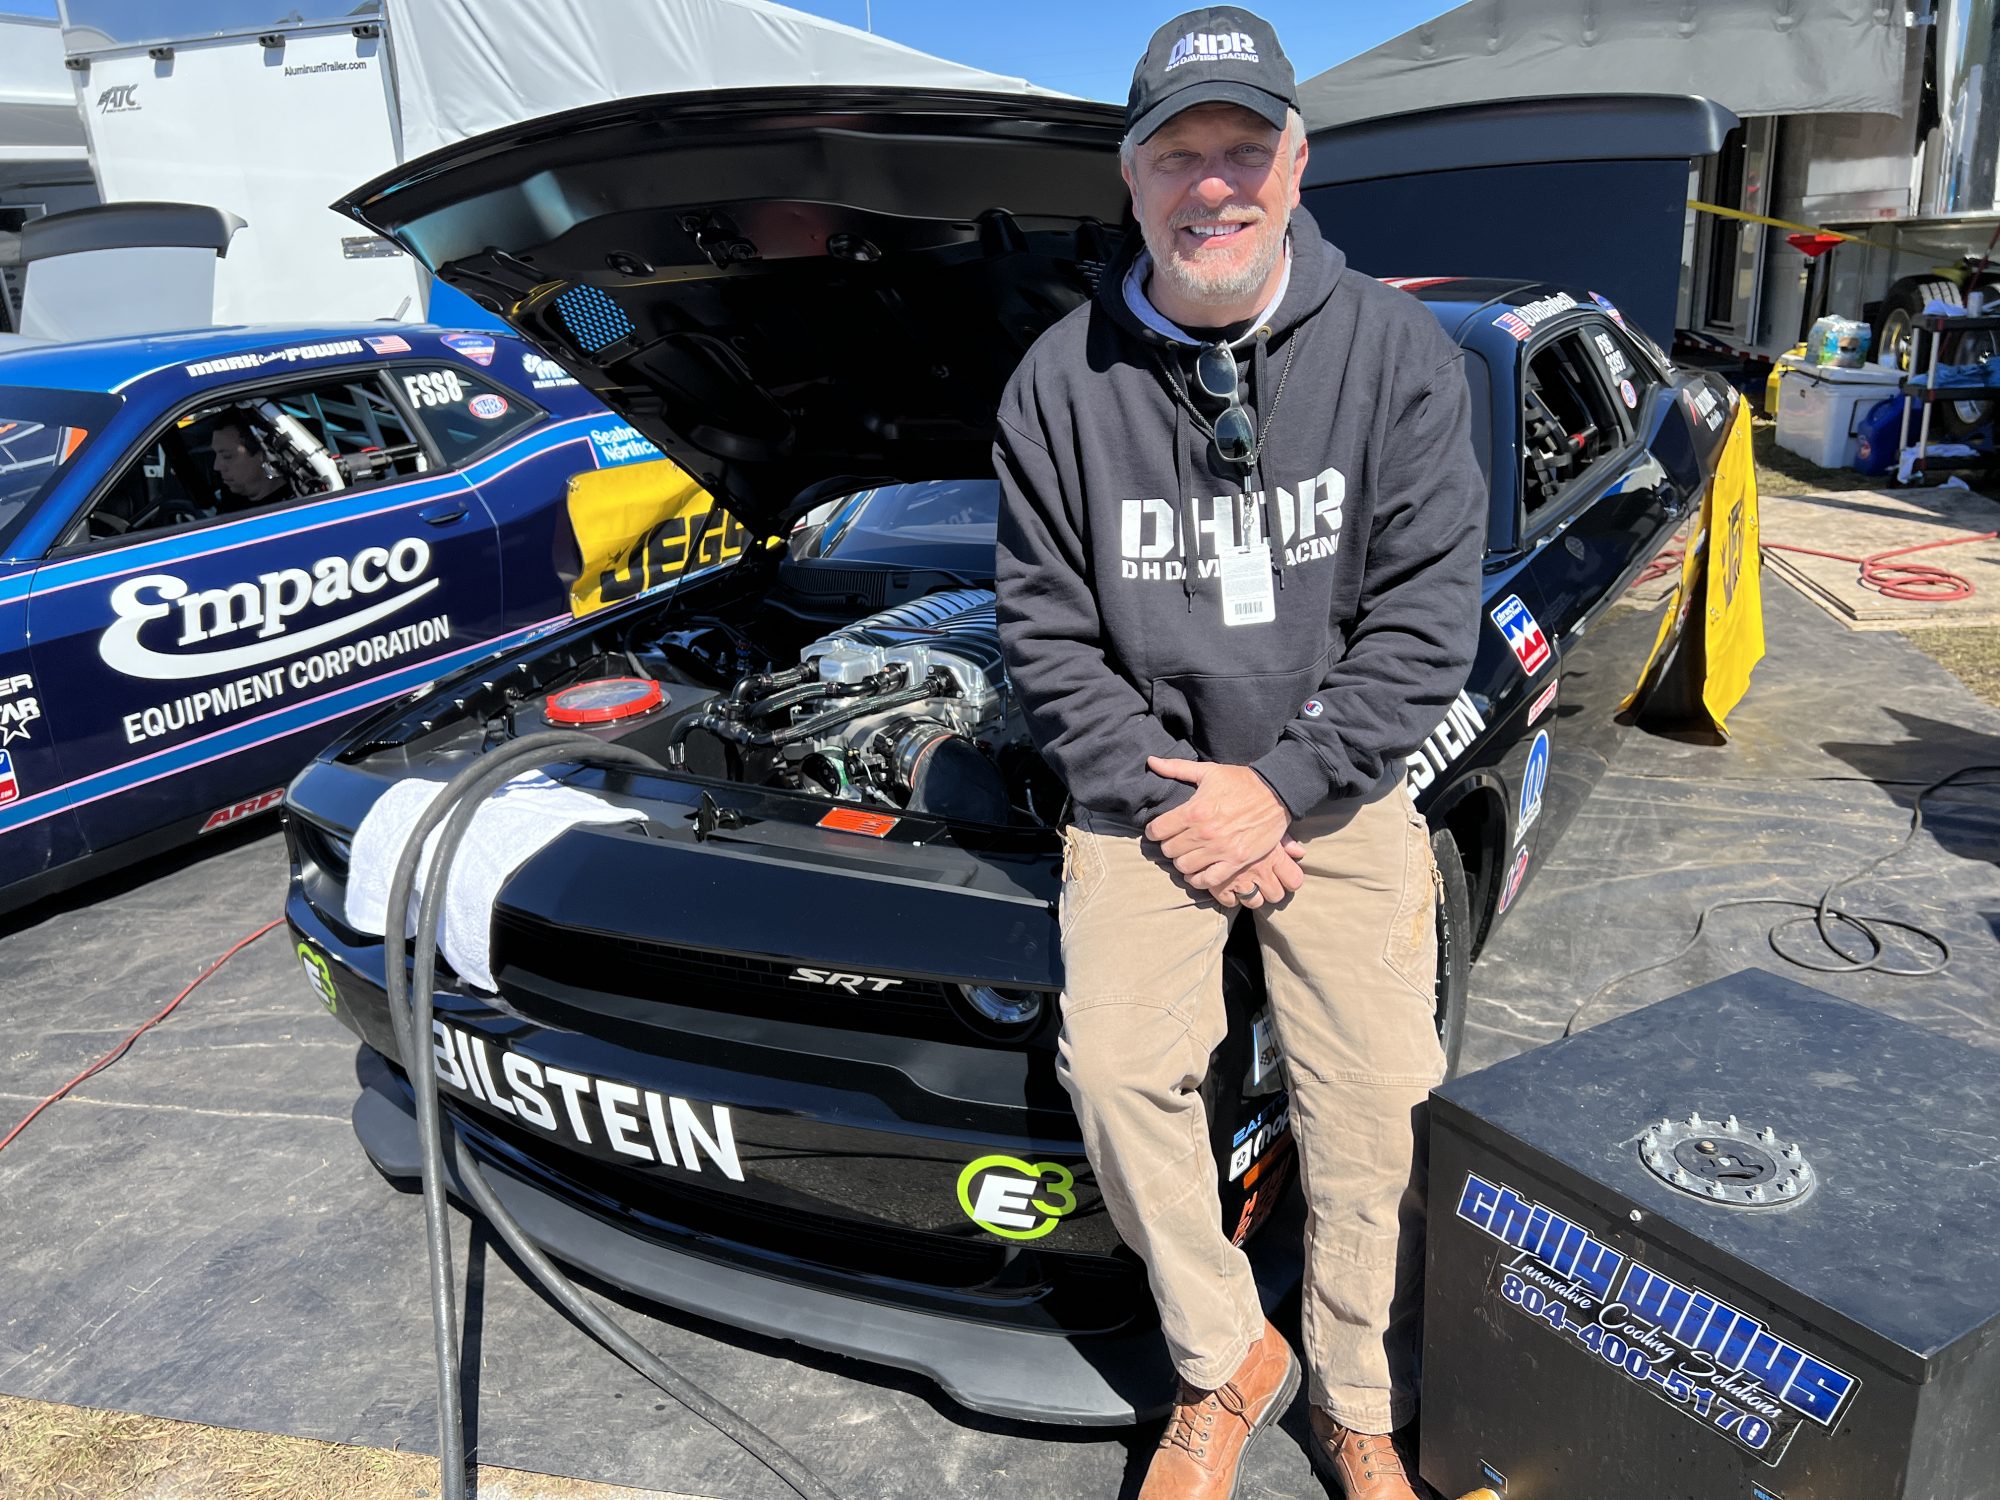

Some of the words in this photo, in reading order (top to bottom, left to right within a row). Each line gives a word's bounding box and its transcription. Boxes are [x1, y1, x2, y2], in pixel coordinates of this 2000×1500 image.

[284, 61, 367, 77] AluminumTrailer.com
[1168, 32, 1257, 66] DHDR
[1219, 52, 1260, 63] RACING
[402, 369, 464, 409] FSS8
[99, 536, 436, 680] Empaco
[122, 667, 286, 745] EQUIPMENT
[288, 614, 451, 690] CORPORATION
[1406, 688, 1487, 802] STEIN
[206, 787, 285, 828] ARP
[788, 967, 904, 996] SRT
[432, 1018, 746, 1183] BILSTEIN
[966, 1158, 1077, 1236] E3
[1500, 1246, 1595, 1309] Innovative
[1597, 1302, 1677, 1364] Cooling
[1679, 1350, 1783, 1419] Solutions
[1500, 1272, 1772, 1450] 804-400-5170
